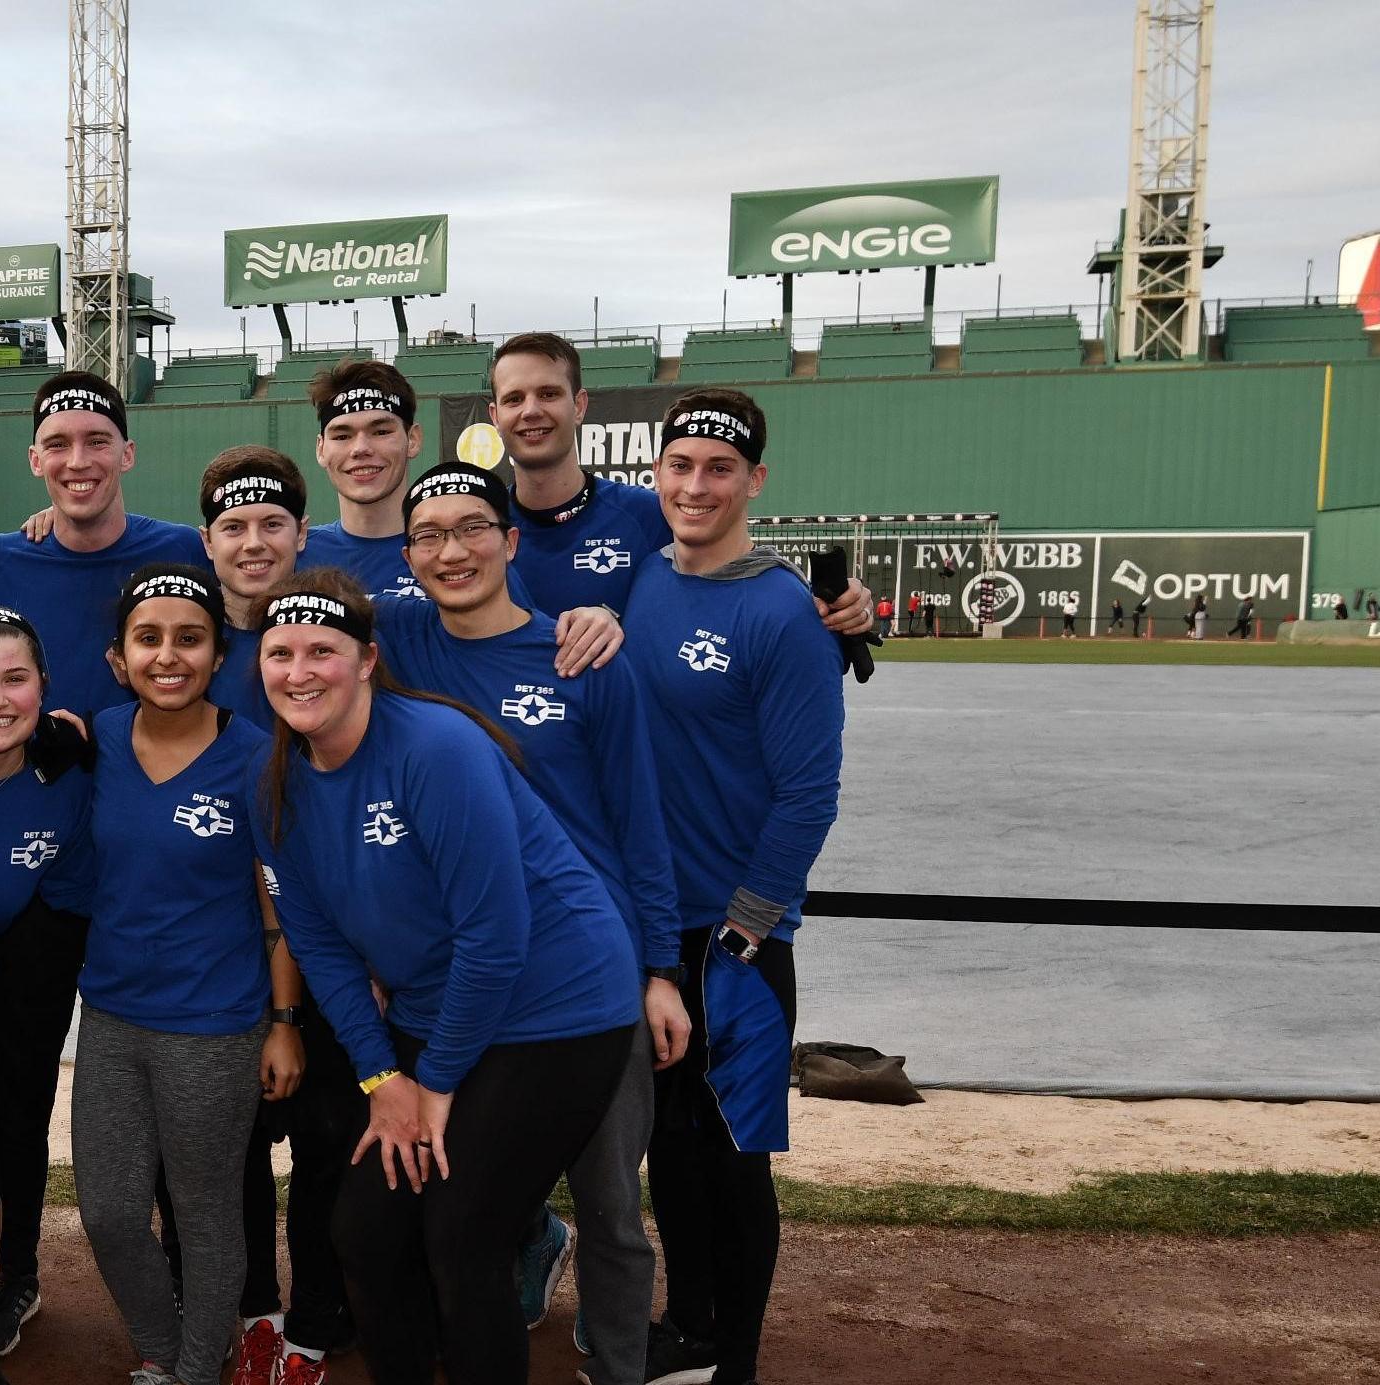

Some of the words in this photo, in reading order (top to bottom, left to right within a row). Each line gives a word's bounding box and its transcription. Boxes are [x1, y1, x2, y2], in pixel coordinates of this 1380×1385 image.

[334, 274, 361, 288] Car
[366, 269, 419, 286] Rental
[52, 388, 111, 409] SPARTAN
[347, 388, 400, 407] SPARAN
[49, 399, 94, 414] 9121
[342, 400, 393, 414] 11541
[687, 423, 736, 442] 9122
[691, 410, 751, 440] SPARTAN
[225, 476, 283, 494] SPARTAN
[423, 472, 487, 488] SPARTAN
[224, 490, 267, 509] 9547
[421, 483, 470, 500] 9120
[585, 539, 602, 547] DET
[604, 538, 621, 546] 365
[776, 543, 827, 553] LEAGUE
[979, 543, 1083, 568] WEBB
[148, 575, 208, 597] SPARTAN
[397, 576, 416, 585] DET
[1153, 573, 1289, 600] OPTUM
[144, 584, 194, 598] 9123
[279, 595, 345, 618] SPARTAN
[1311, 593, 1341, 608] 379
[275, 610, 326, 626] 9127
[695, 629, 711, 639] DET
[711, 634, 727, 645] 365
[514, 684, 535, 693] DET
[537, 686, 555, 695] 365
[192, 793, 212, 804] DET
[213, 798, 230, 809] 365
[23, 831, 40, 839] DET
[41, 830, 56, 839] 365
